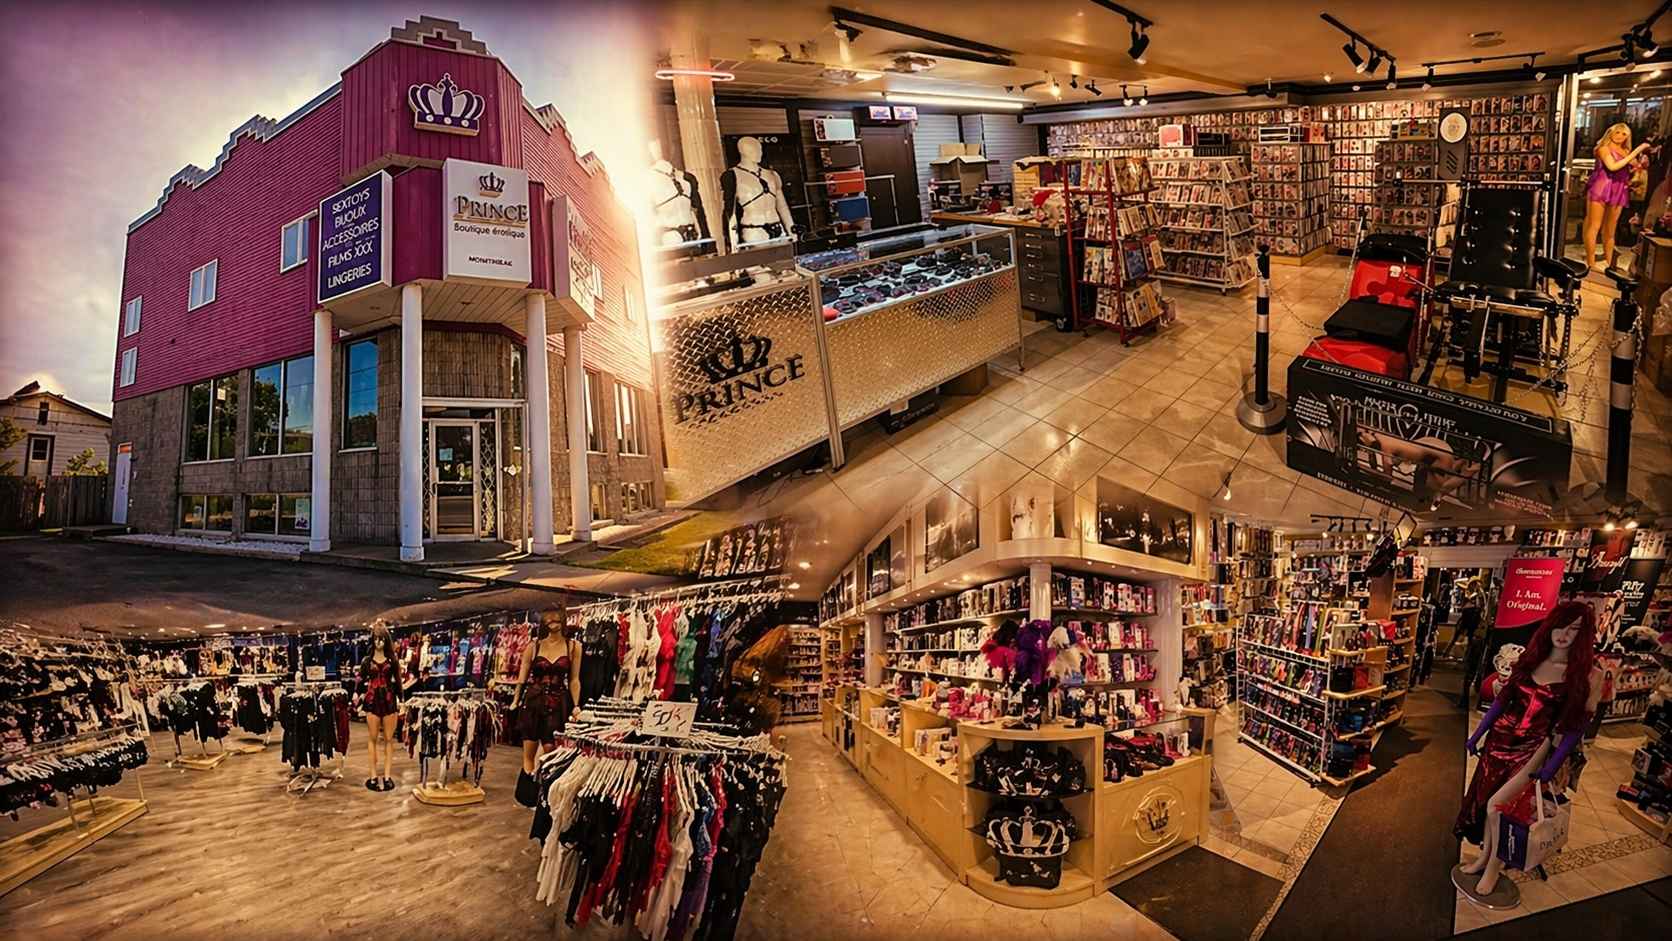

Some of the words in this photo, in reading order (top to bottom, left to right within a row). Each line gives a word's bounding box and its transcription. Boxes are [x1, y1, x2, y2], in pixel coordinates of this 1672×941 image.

[332, 187, 370, 214] SEXTOYS
[454, 195, 529, 222] PRINCE
[322, 217, 379, 251] ACCESSOIRES
[454, 222, 490, 235] Boutique
[328, 248, 352, 268] FILMS
[353, 240, 373, 258] XXX
[327, 263, 372, 288] LINGERIES
[671, 353, 806, 425] PRINCE
